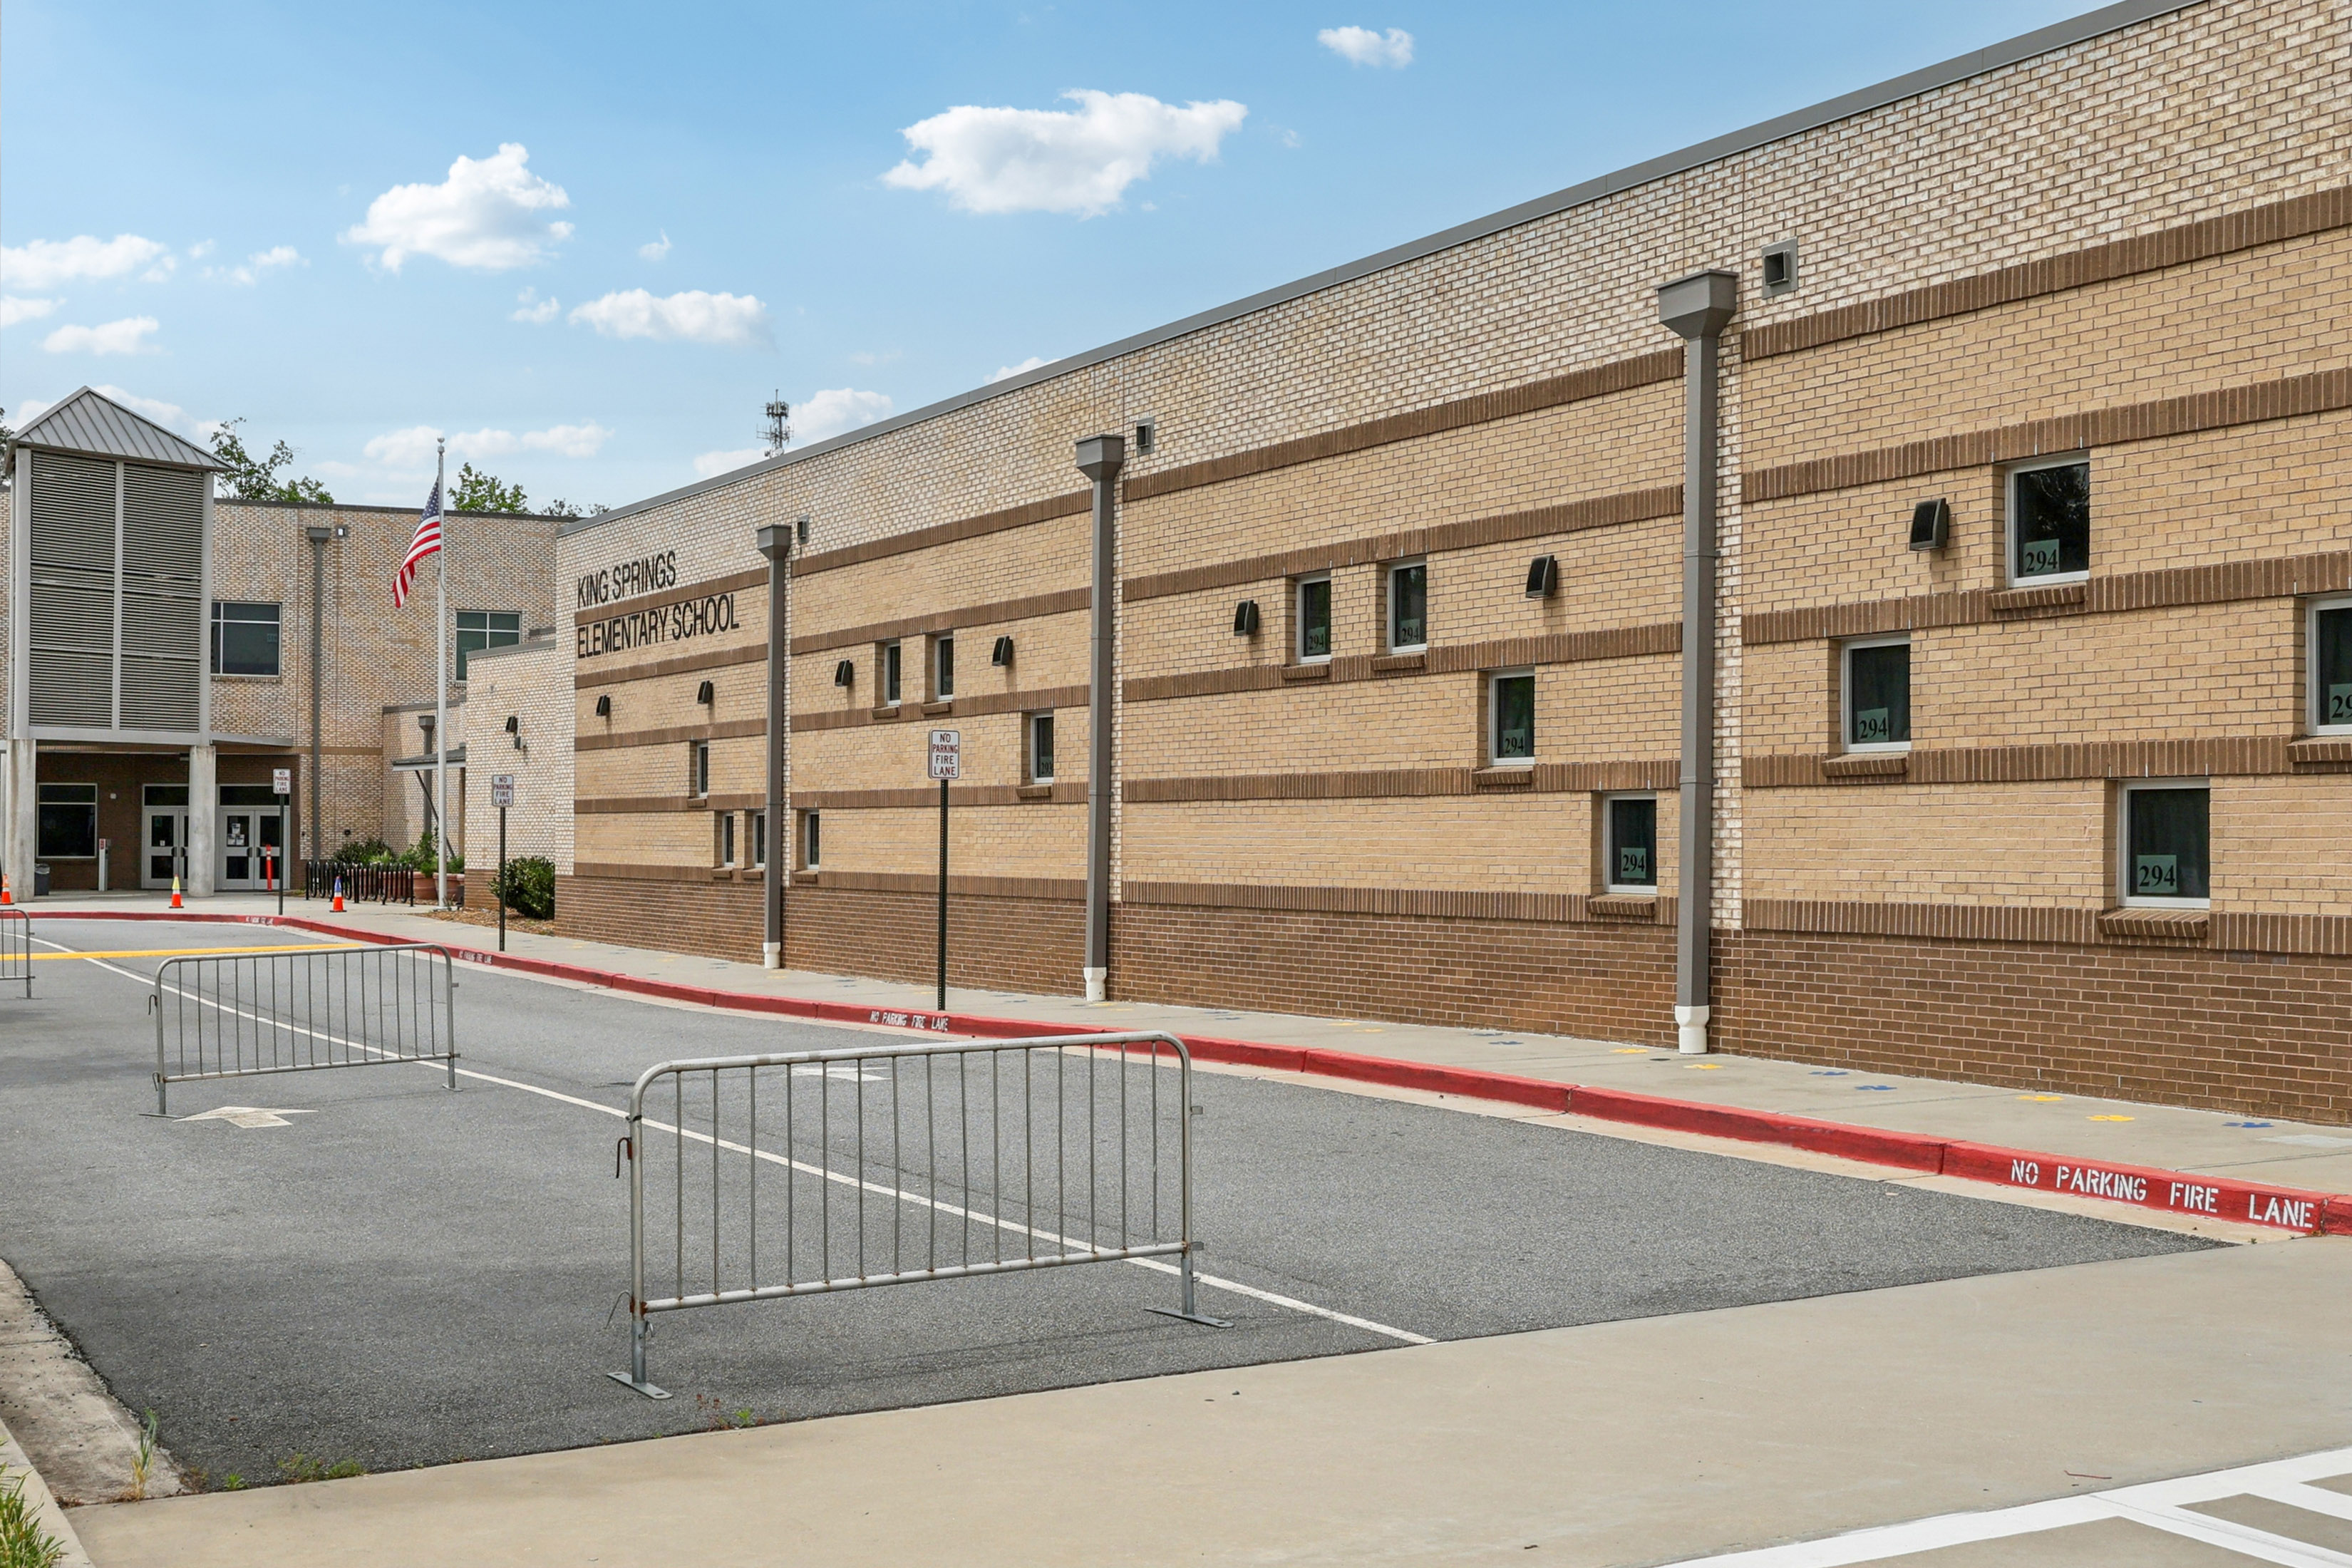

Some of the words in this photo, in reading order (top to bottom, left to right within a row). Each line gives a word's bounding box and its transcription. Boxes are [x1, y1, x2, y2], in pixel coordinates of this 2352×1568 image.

[2025, 549, 2058, 572] 294
[578, 569, 609, 609] KING
[612, 550, 676, 599] SPRINGS
[577, 607, 669, 659] ELEMENTARY
[672, 593, 739, 641] SCHOOL
[1401, 626, 1420, 642] 294
[1309, 634, 1324, 650] 294
[1859, 716, 1887, 739] 294
[940, 733, 951, 743] NO
[1505, 736, 1524, 754] 294
[932, 744, 958, 753] PARKING
[936, 755, 954, 765] FIRE
[934, 765, 956, 776] LANE
[1622, 854, 1645, 872] 294
[2138, 865, 2175, 887] 294
[870, 1011, 880, 1023] NO
[882, 1012, 907, 1026] PARKING
[911, 1015, 926, 1028] FIRE
[931, 1016, 949, 1031] LANE
[2011, 1159, 2039, 1185] NO
[2056, 1165, 2147, 1202] PARKING
[2170, 1182, 2219, 1213] FIRE
[2248, 1194, 2315, 1228] LANE
